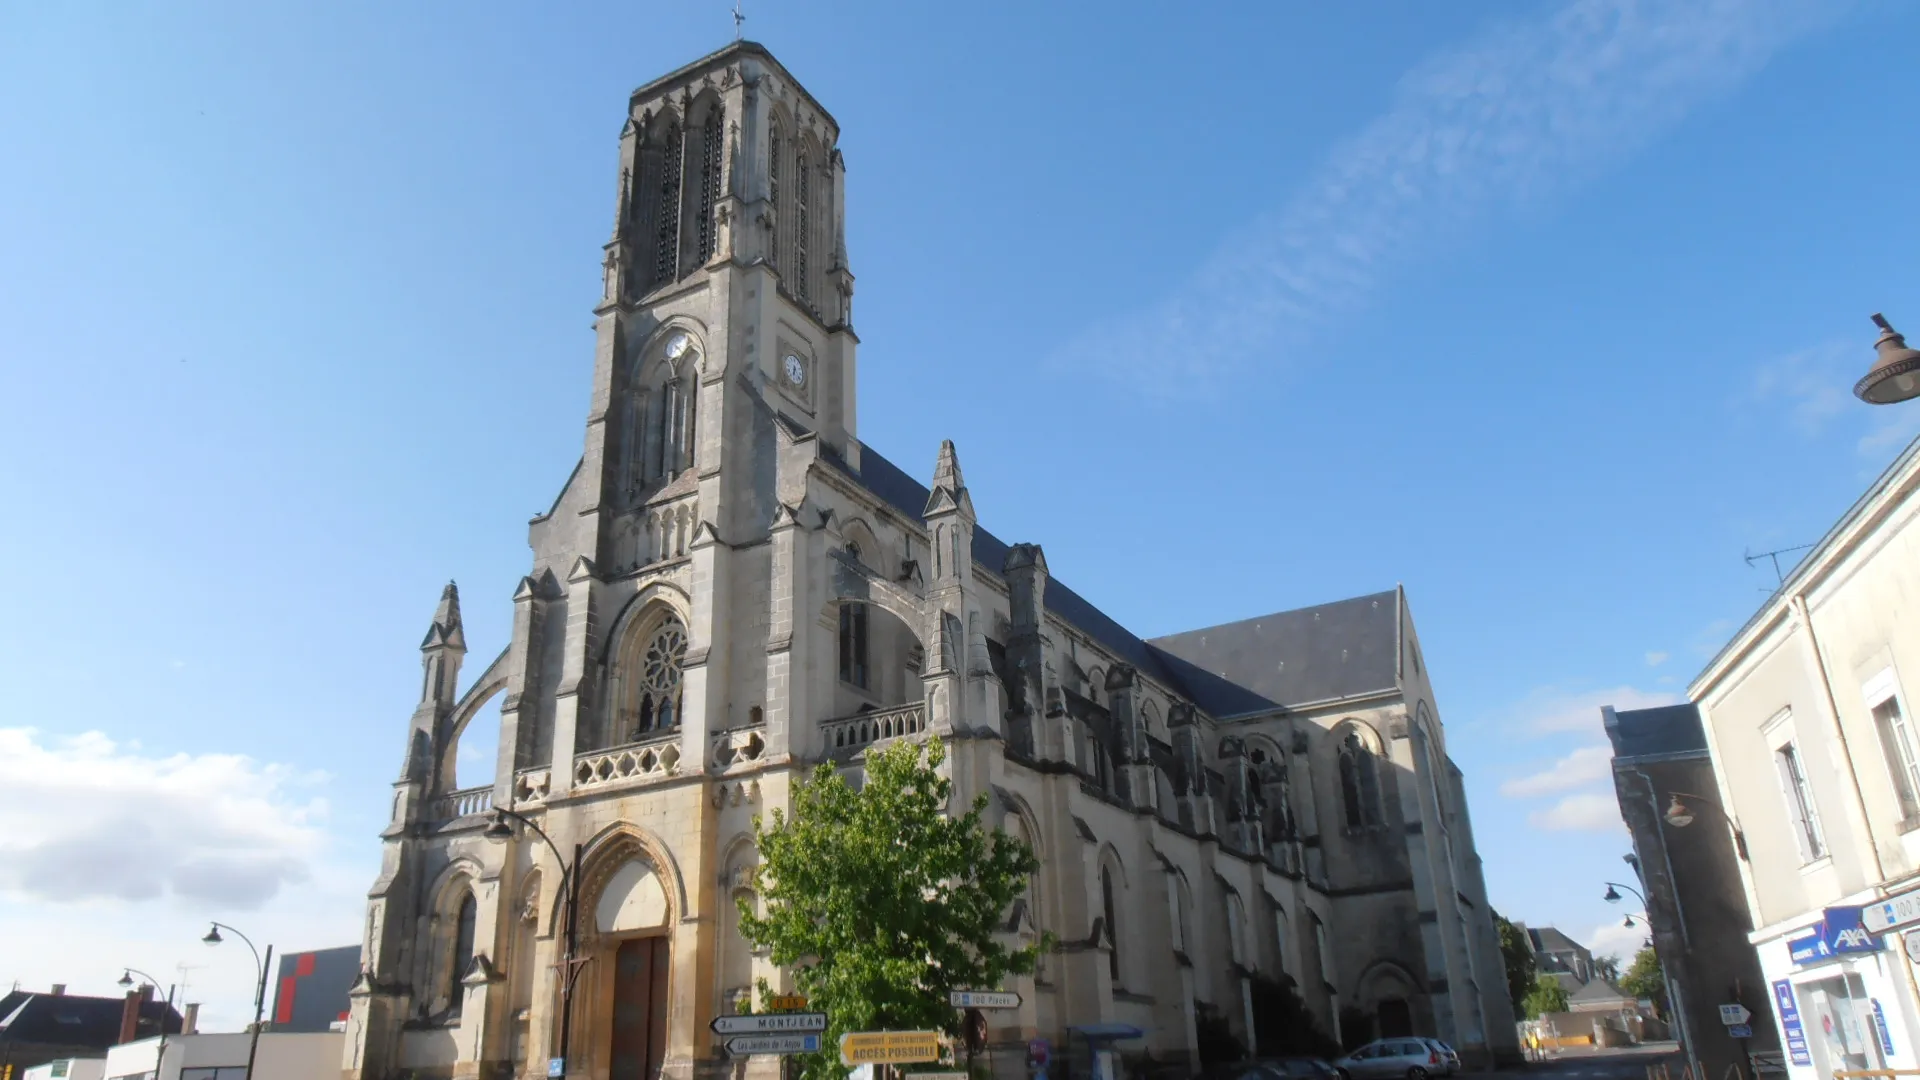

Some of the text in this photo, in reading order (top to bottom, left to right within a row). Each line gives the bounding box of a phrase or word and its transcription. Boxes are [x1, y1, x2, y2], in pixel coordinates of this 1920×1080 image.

[1833, 928, 1873, 949] AXA
[758, 1017, 822, 1029] MONTJEAN
[852, 1045, 935, 1061] ACCÈS POSSIBLE
